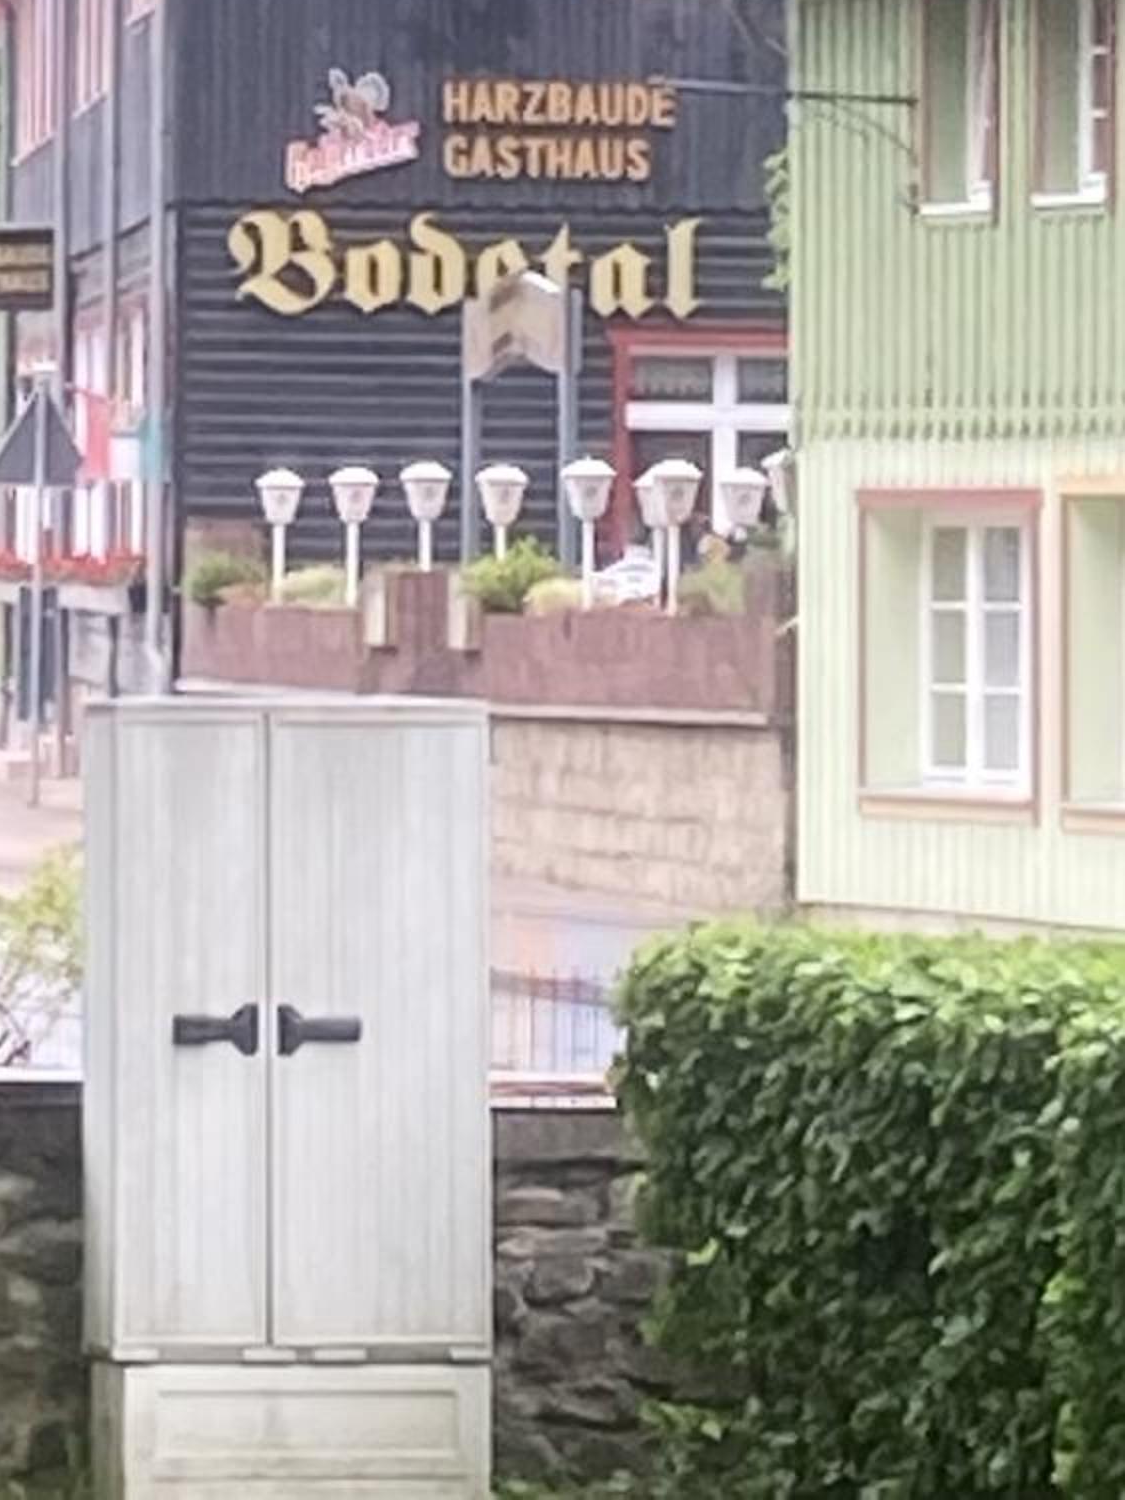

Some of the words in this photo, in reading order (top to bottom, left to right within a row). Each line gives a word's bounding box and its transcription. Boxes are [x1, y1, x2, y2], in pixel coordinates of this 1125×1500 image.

[442, 79, 676, 127] HARZBAUDE
[442, 133, 652, 181] GASTHAUS
[227, 209, 704, 320] Bodetal
